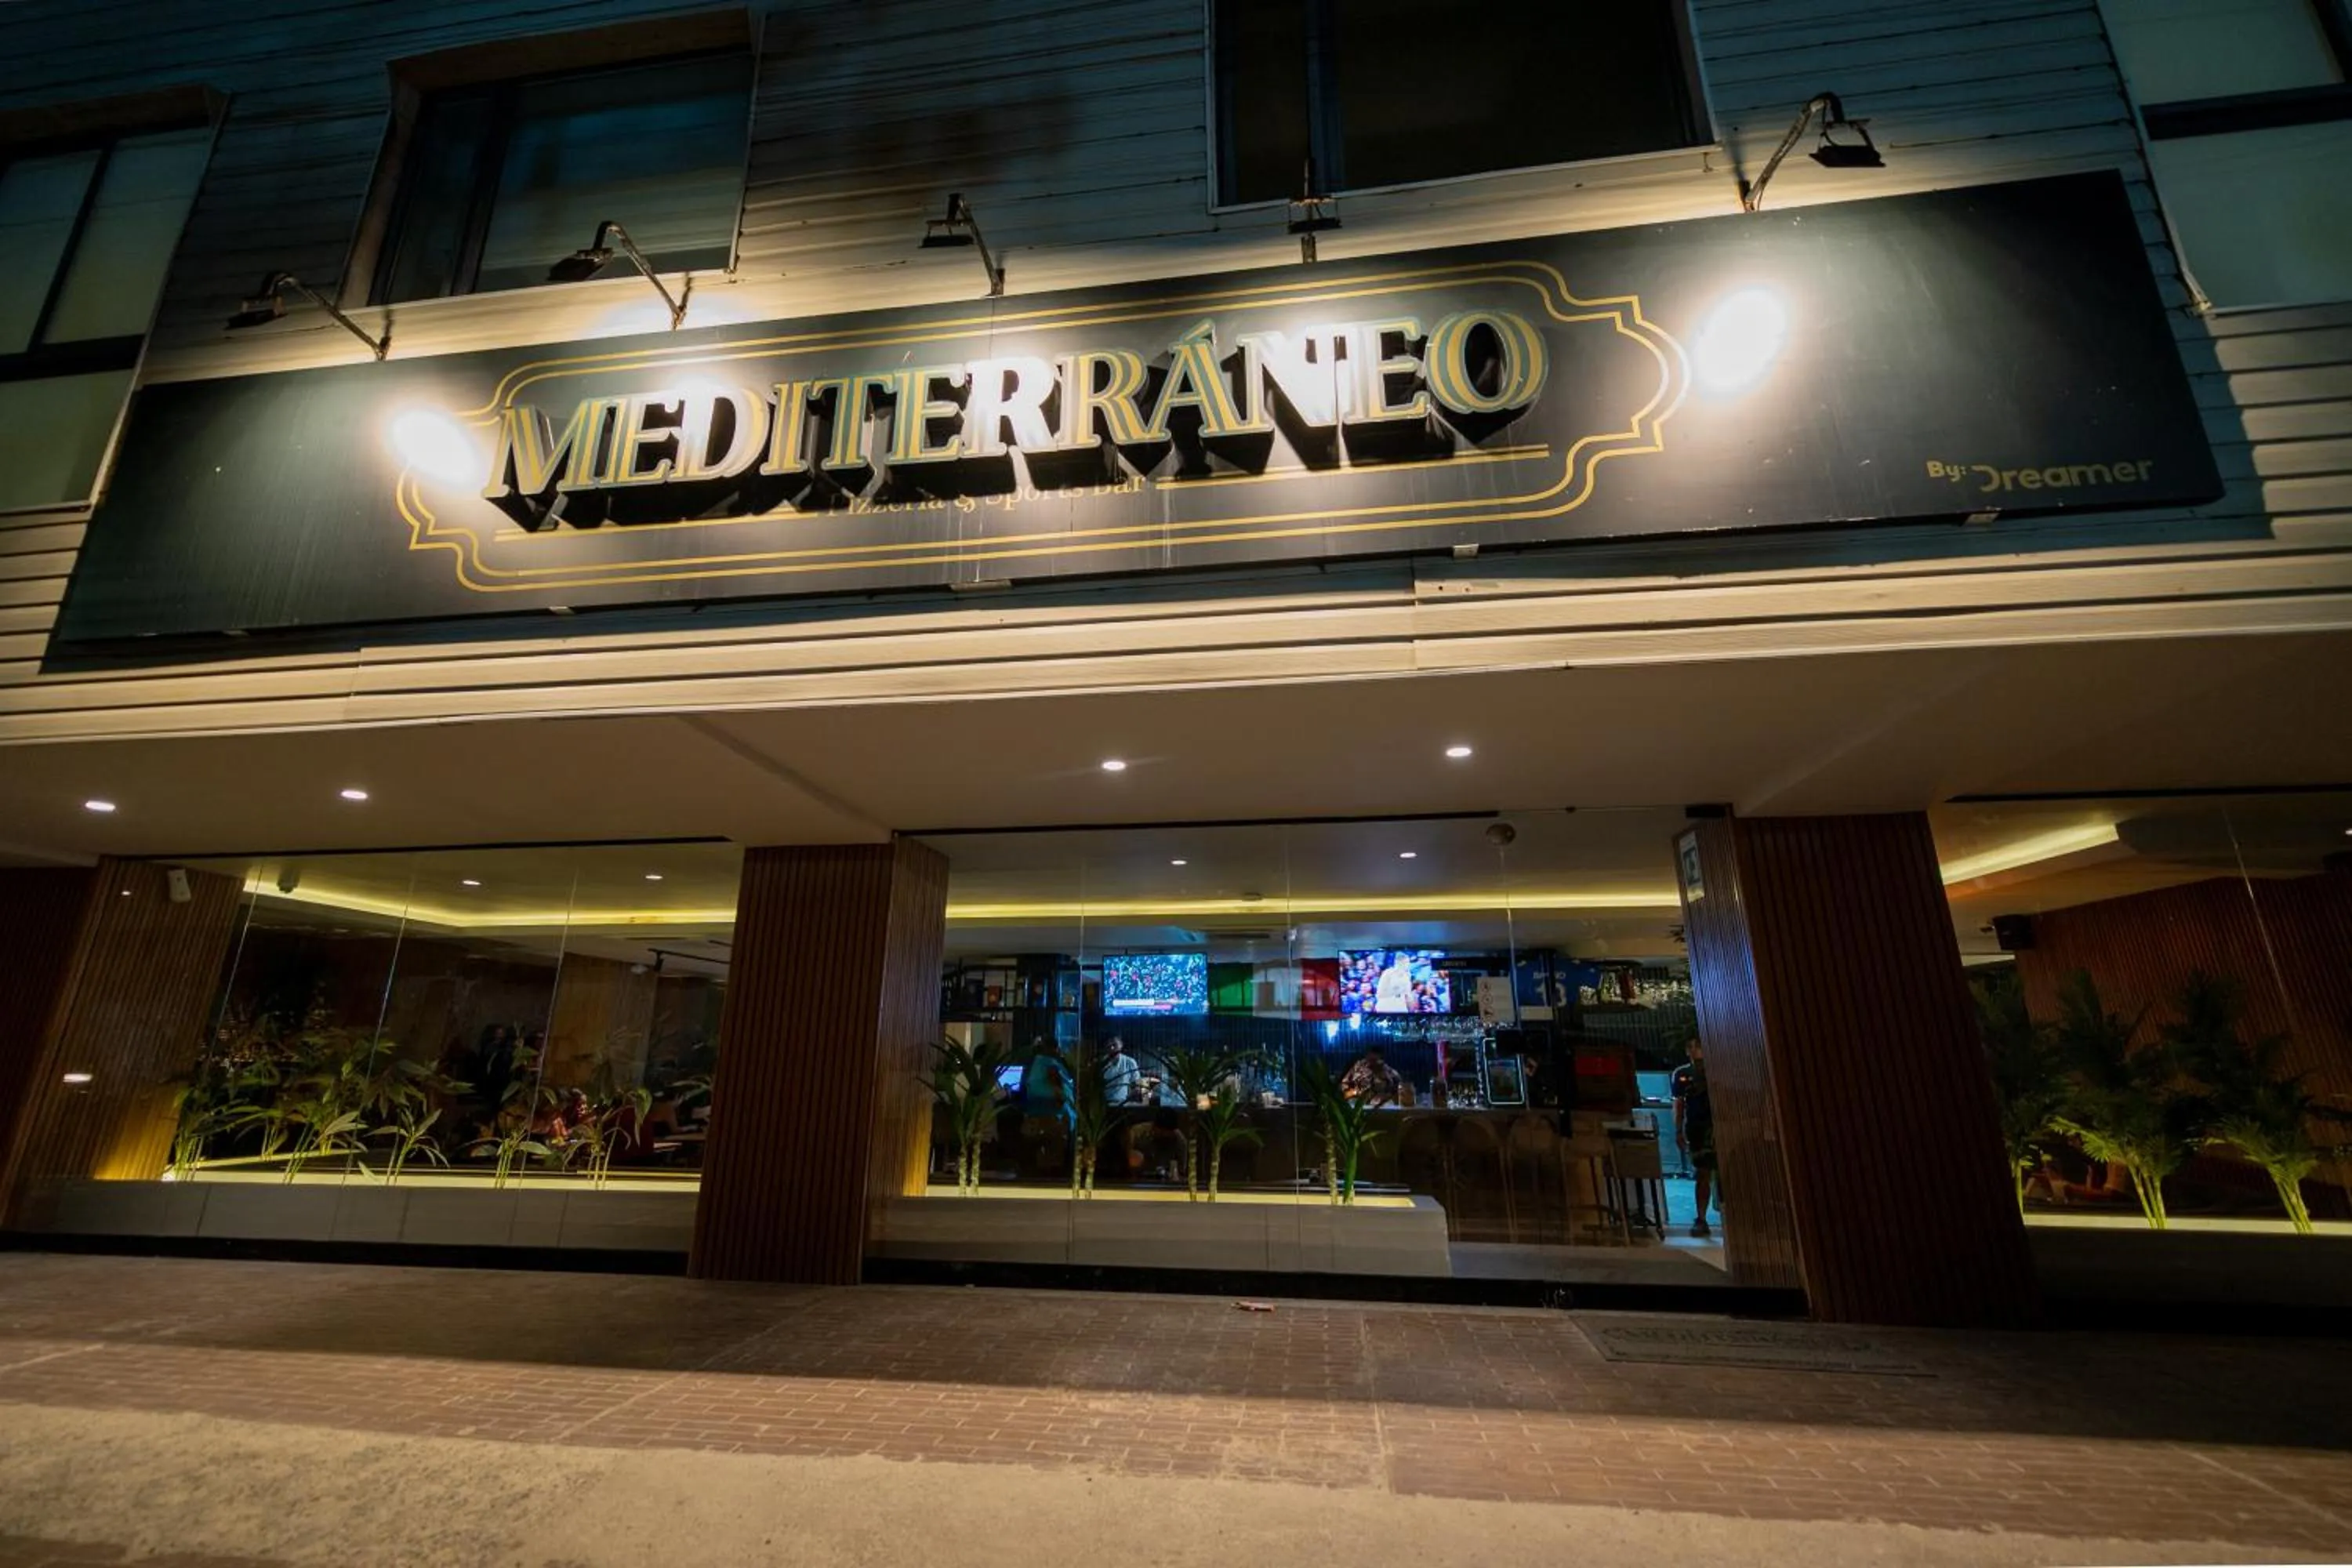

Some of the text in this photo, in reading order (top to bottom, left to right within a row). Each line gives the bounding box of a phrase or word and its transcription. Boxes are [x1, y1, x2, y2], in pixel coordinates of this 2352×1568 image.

[482, 310, 1549, 499] MEDITERRÁNEO
[1926, 459, 2154, 492] By: Dreamer
